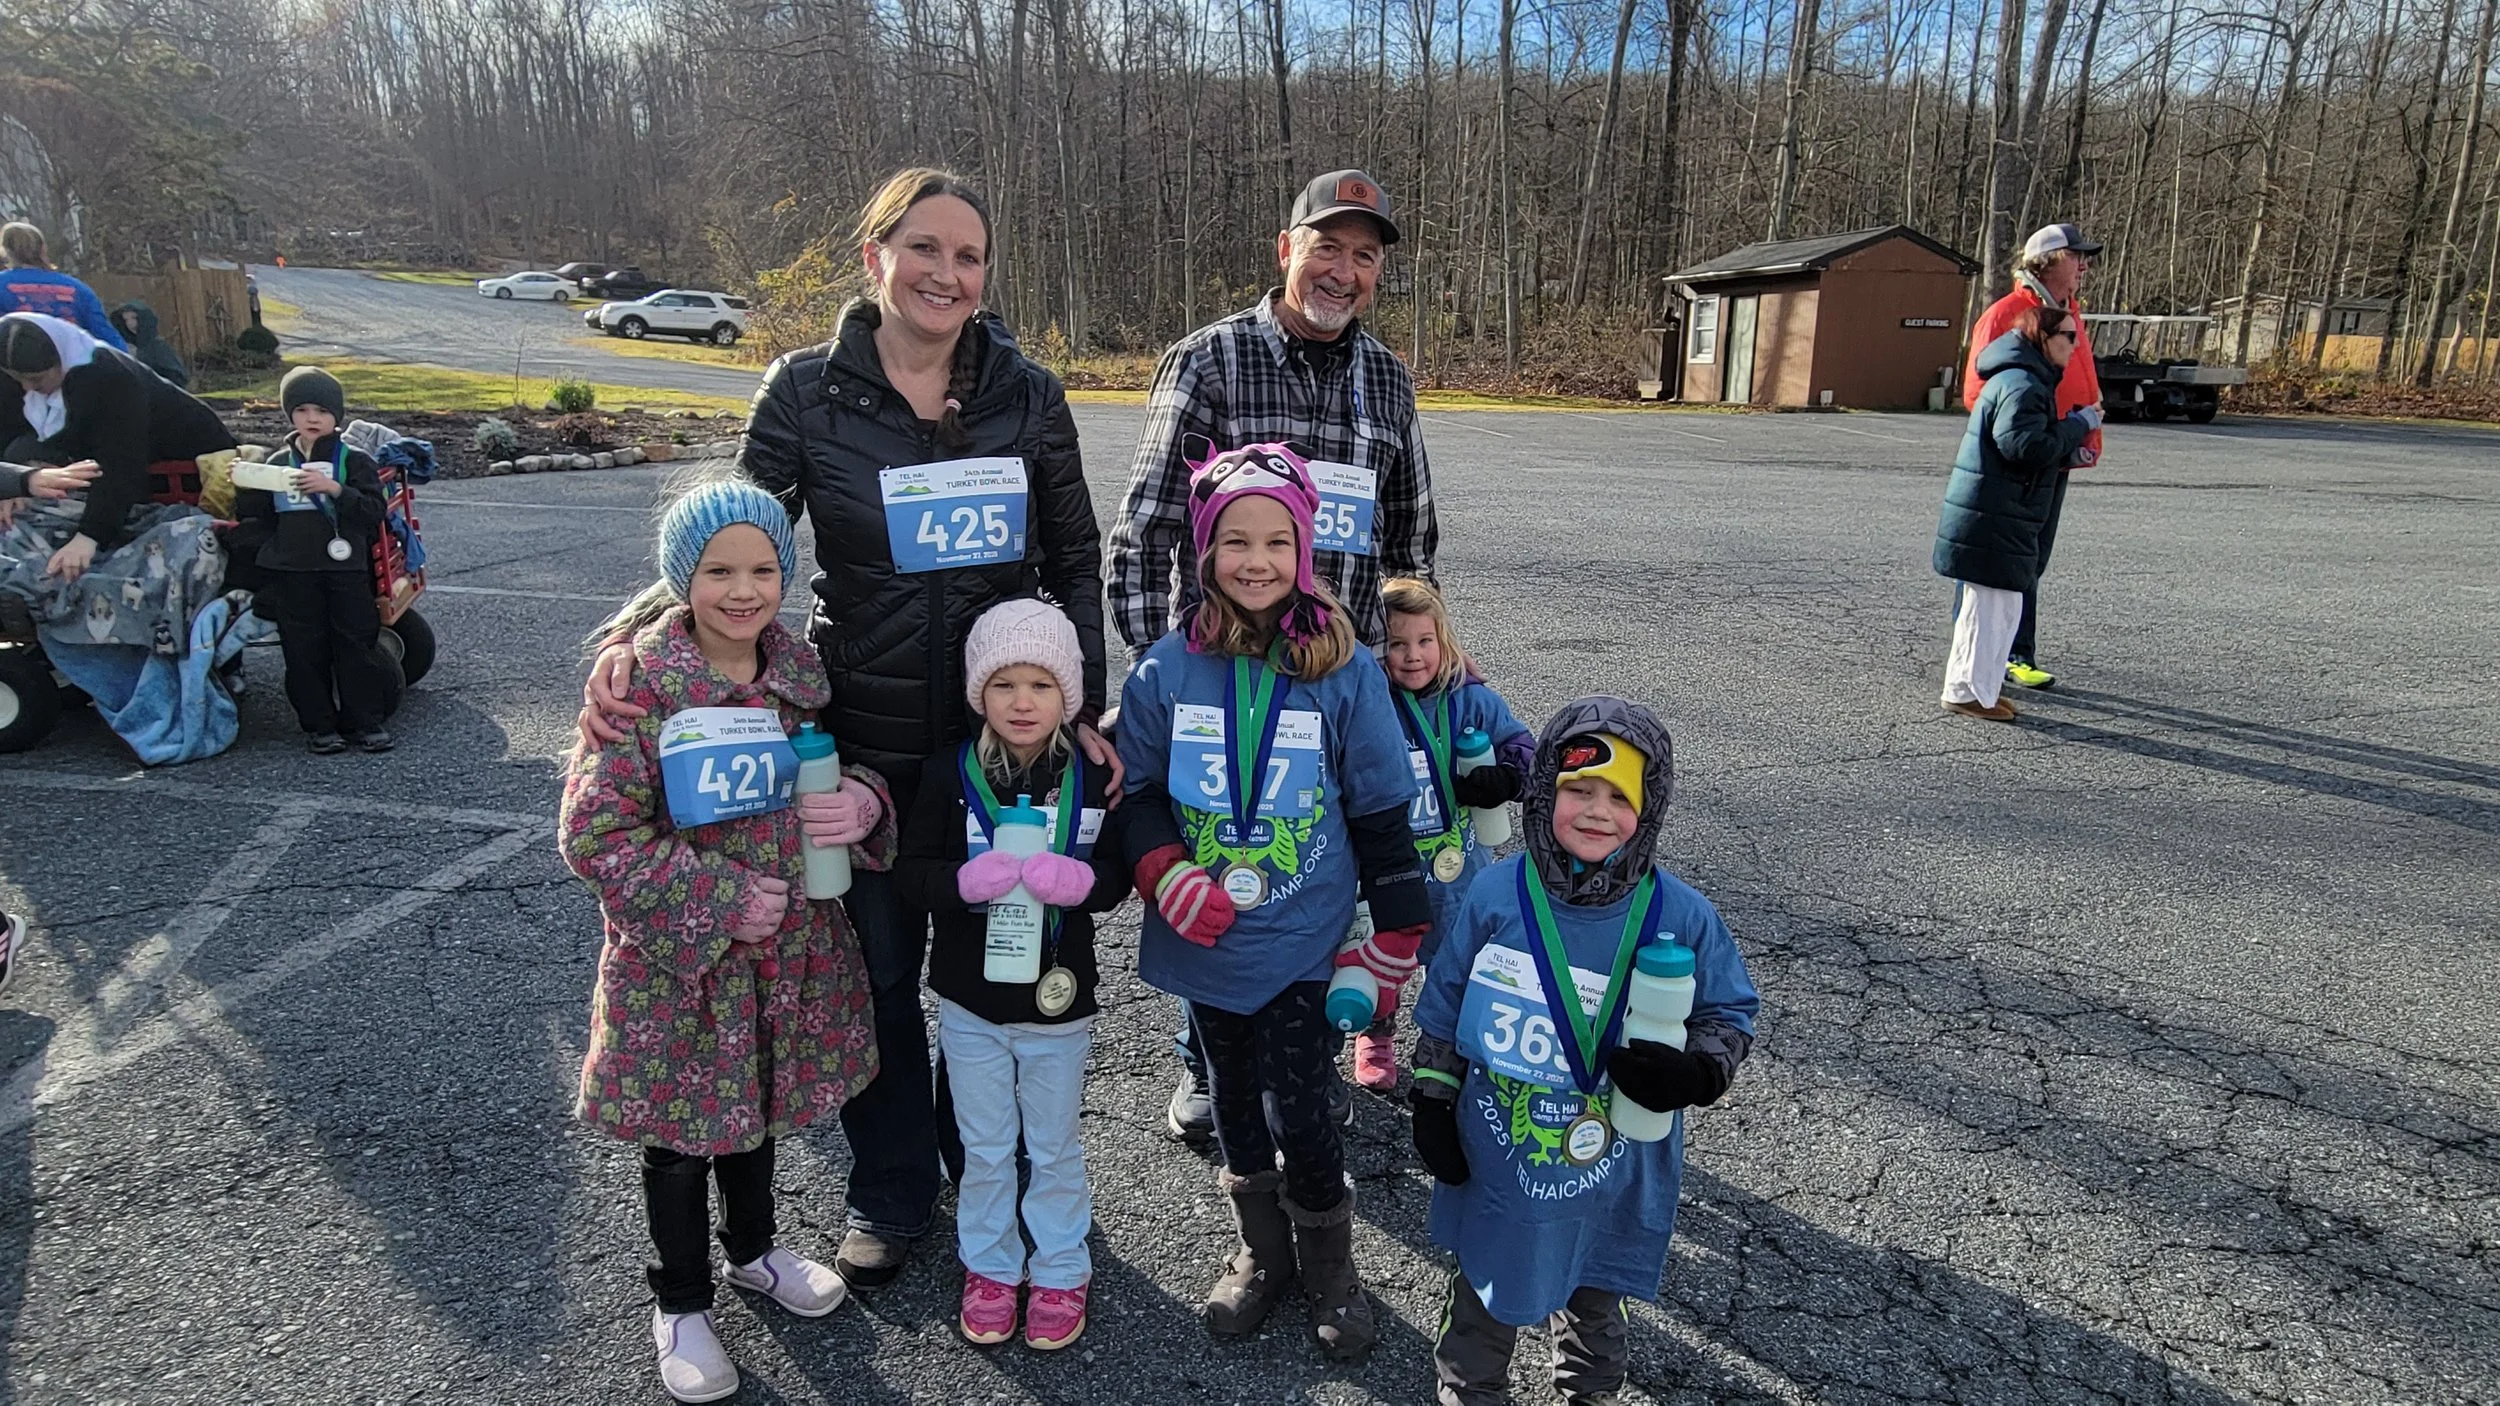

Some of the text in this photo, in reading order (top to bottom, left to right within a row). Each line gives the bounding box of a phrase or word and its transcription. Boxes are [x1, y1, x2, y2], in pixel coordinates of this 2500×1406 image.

[946, 479, 977, 489] TURKEY
[980, 478, 1001, 486] BOWL
[1318, 478, 1341, 486] TURKEY
[1314, 500, 1357, 539] 55
[916, 504, 1009, 552] 425
[672, 716, 698, 728] TEL HAI
[719, 726, 746, 735] TURKEY
[1292, 731, 1313, 740] RACE
[697, 752, 776, 802] 421
[1199, 753, 1290, 800] 37
[1225, 823, 1238, 835] TE
[1219, 834, 1238, 843] Camp
[1493, 952, 1519, 967] TEL HAI
[1580, 984, 1605, 997] Annua
[1578, 994, 1600, 1008] OWL
[1492, 1056, 1565, 1083] November 27, 2025
[1539, 1099, 1579, 1114] TEL HAI
[1477, 1095, 1510, 1148] 2025
[1531, 1110, 1553, 1123] Camp
